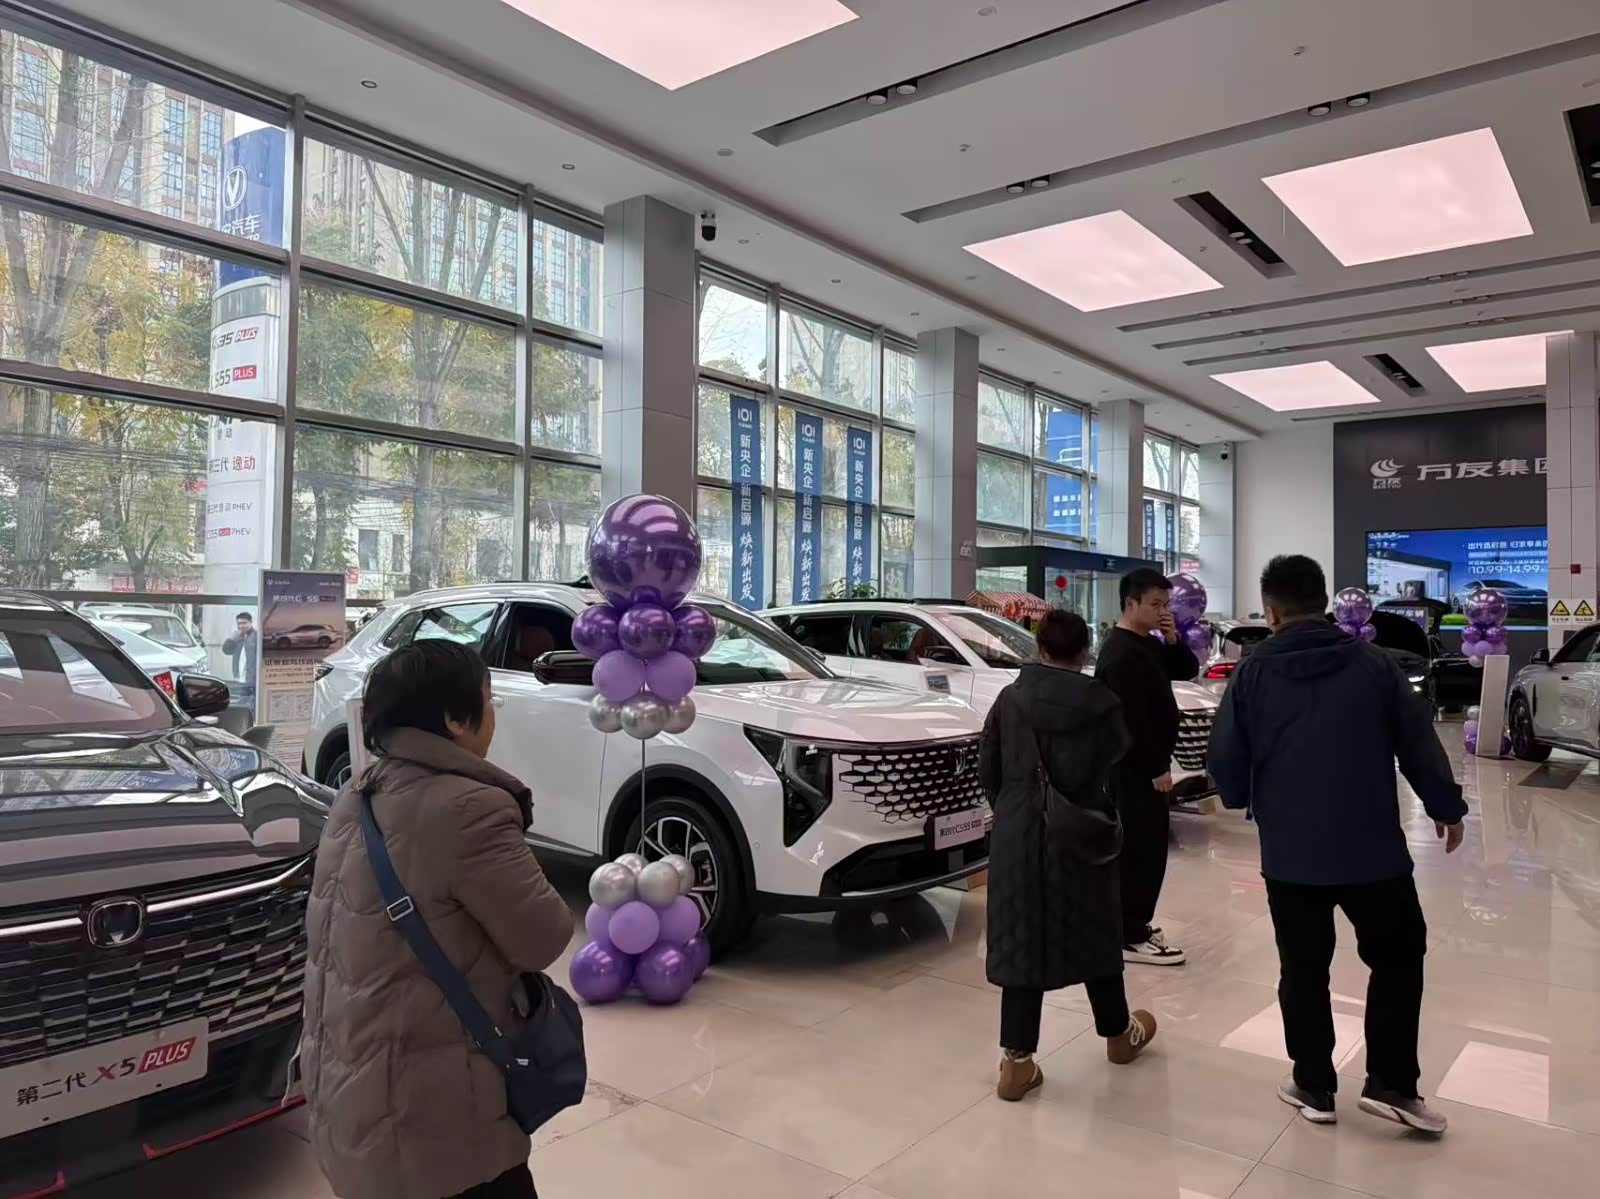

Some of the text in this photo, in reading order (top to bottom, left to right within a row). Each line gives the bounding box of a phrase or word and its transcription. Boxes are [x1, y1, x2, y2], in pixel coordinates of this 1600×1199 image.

[233, 365, 256, 381] PLUS
[232, 455, 256, 472] 逸动
[739, 434, 752, 478] 新央企
[802, 448, 814, 489] 新央企
[853, 460, 864, 499] 新央企
[232, 502, 252, 511] PHEV
[739, 531, 756, 602] 焕新出发
[17, 1072, 86, 1107] 第二代
[144, 1041, 191, 1070] PLUS
